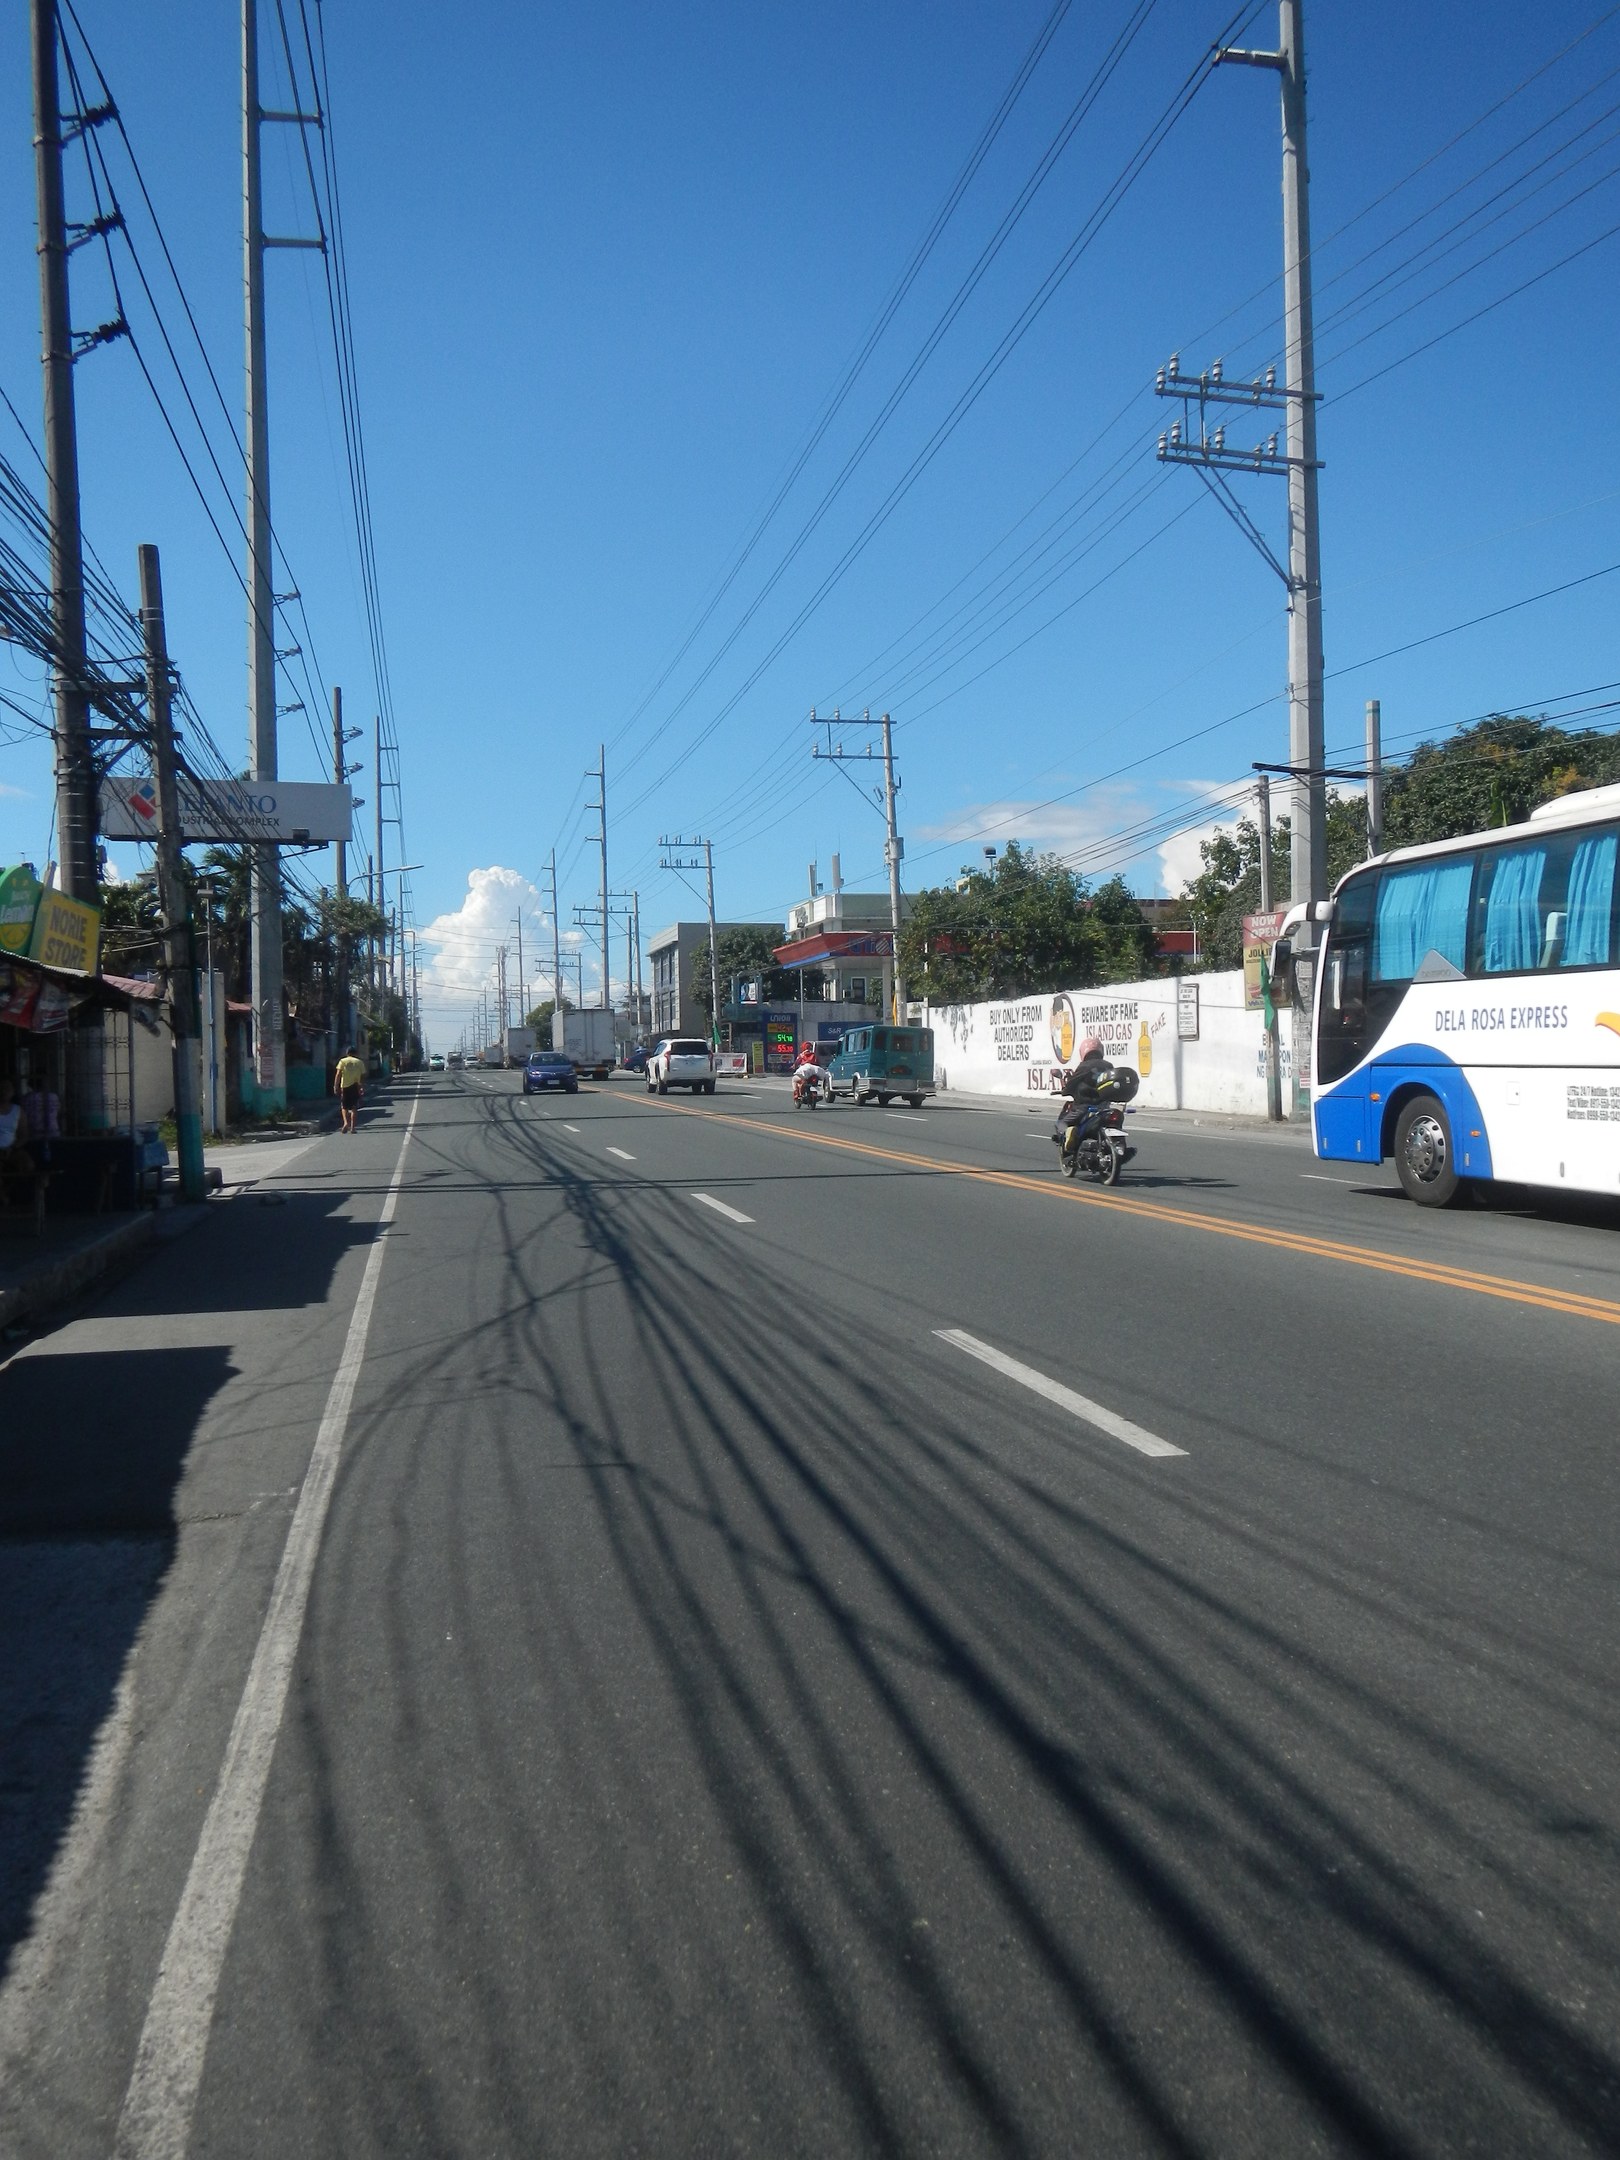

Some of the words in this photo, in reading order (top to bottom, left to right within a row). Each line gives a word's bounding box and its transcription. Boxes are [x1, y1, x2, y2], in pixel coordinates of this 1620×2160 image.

[49, 904, 88, 944] NORIE
[1251, 915, 1277, 928] NOW
[1250, 927, 1279, 939] OPEN
[45, 936, 87, 969] STORE
[990, 1009, 1001, 1025] BUY
[1002, 1007, 1020, 1024] ONLY
[1022, 1004, 1042, 1022] FROM
[1081, 1005, 1109, 1024] BEWARE
[1110, 1004, 1119, 1021] OF
[1120, 1002, 1138, 1021] FAKE
[1435, 1009, 1466, 1031] DELA
[1471, 1007, 1505, 1031] ROSA
[1510, 1005, 1568, 1029] EXPRESS
[994, 1025, 1034, 1043] AUTHORIZED
[1086, 1024, 1114, 1041] ISLAND
[1115, 1023, 1133, 1041] GAS
[1150, 1012, 1167, 1038] FAKE
[998, 1044, 1029, 1061] DEALERS
[1105, 1042, 1128, 1056] WEIGHT
